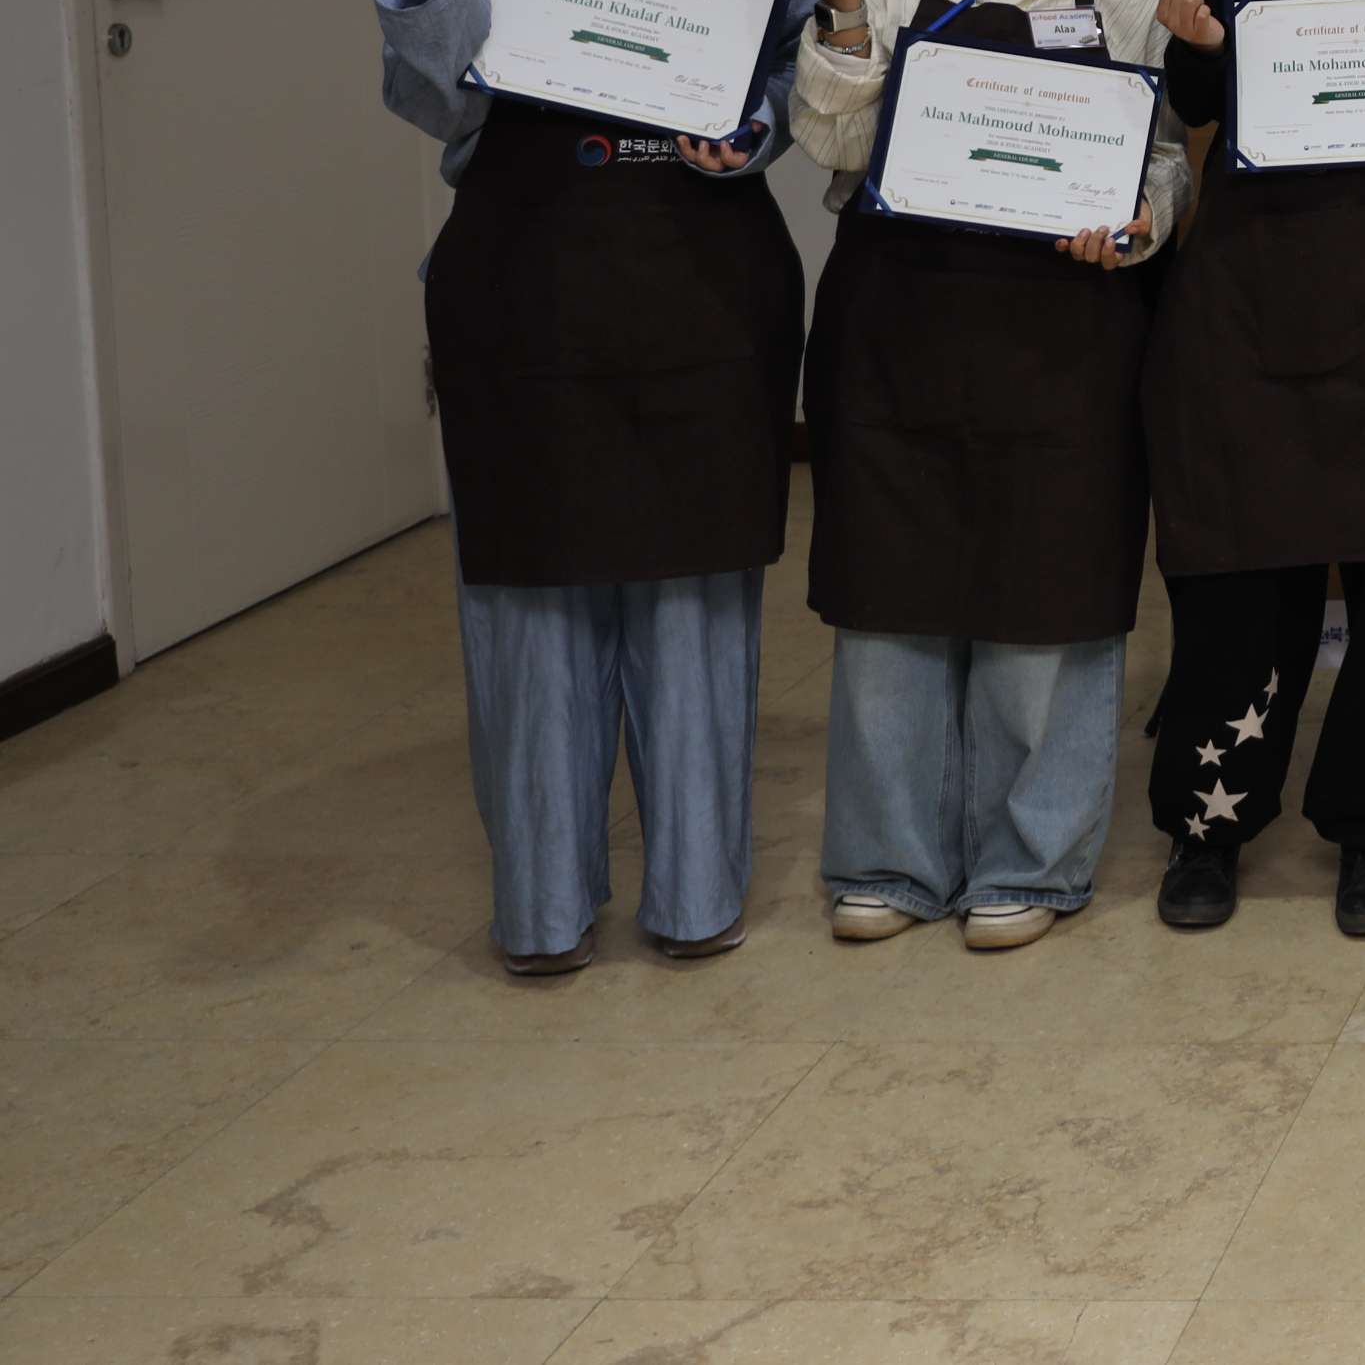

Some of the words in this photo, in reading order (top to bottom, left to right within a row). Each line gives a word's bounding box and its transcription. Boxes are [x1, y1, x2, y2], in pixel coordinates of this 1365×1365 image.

[609, 1, 662, 23] Khalaf
[664, 15, 709, 35] Allam
[1054, 25, 1076, 34] Alaa
[1295, 25, 1344, 36] Certificate
[1350, 23, 1360, 34] of
[1273, 59, 1303, 73] Hala
[966, 77, 1018, 94] Certificate
[1023, 86, 1033, 96] of
[1036, 88, 1090, 104] completion
[920, 106, 952, 121] Alaa
[958, 111, 1033, 132] Mahmoud
[1038, 123, 1124, 145] Mohammed
[618, 138, 673, 154] 한국문화
